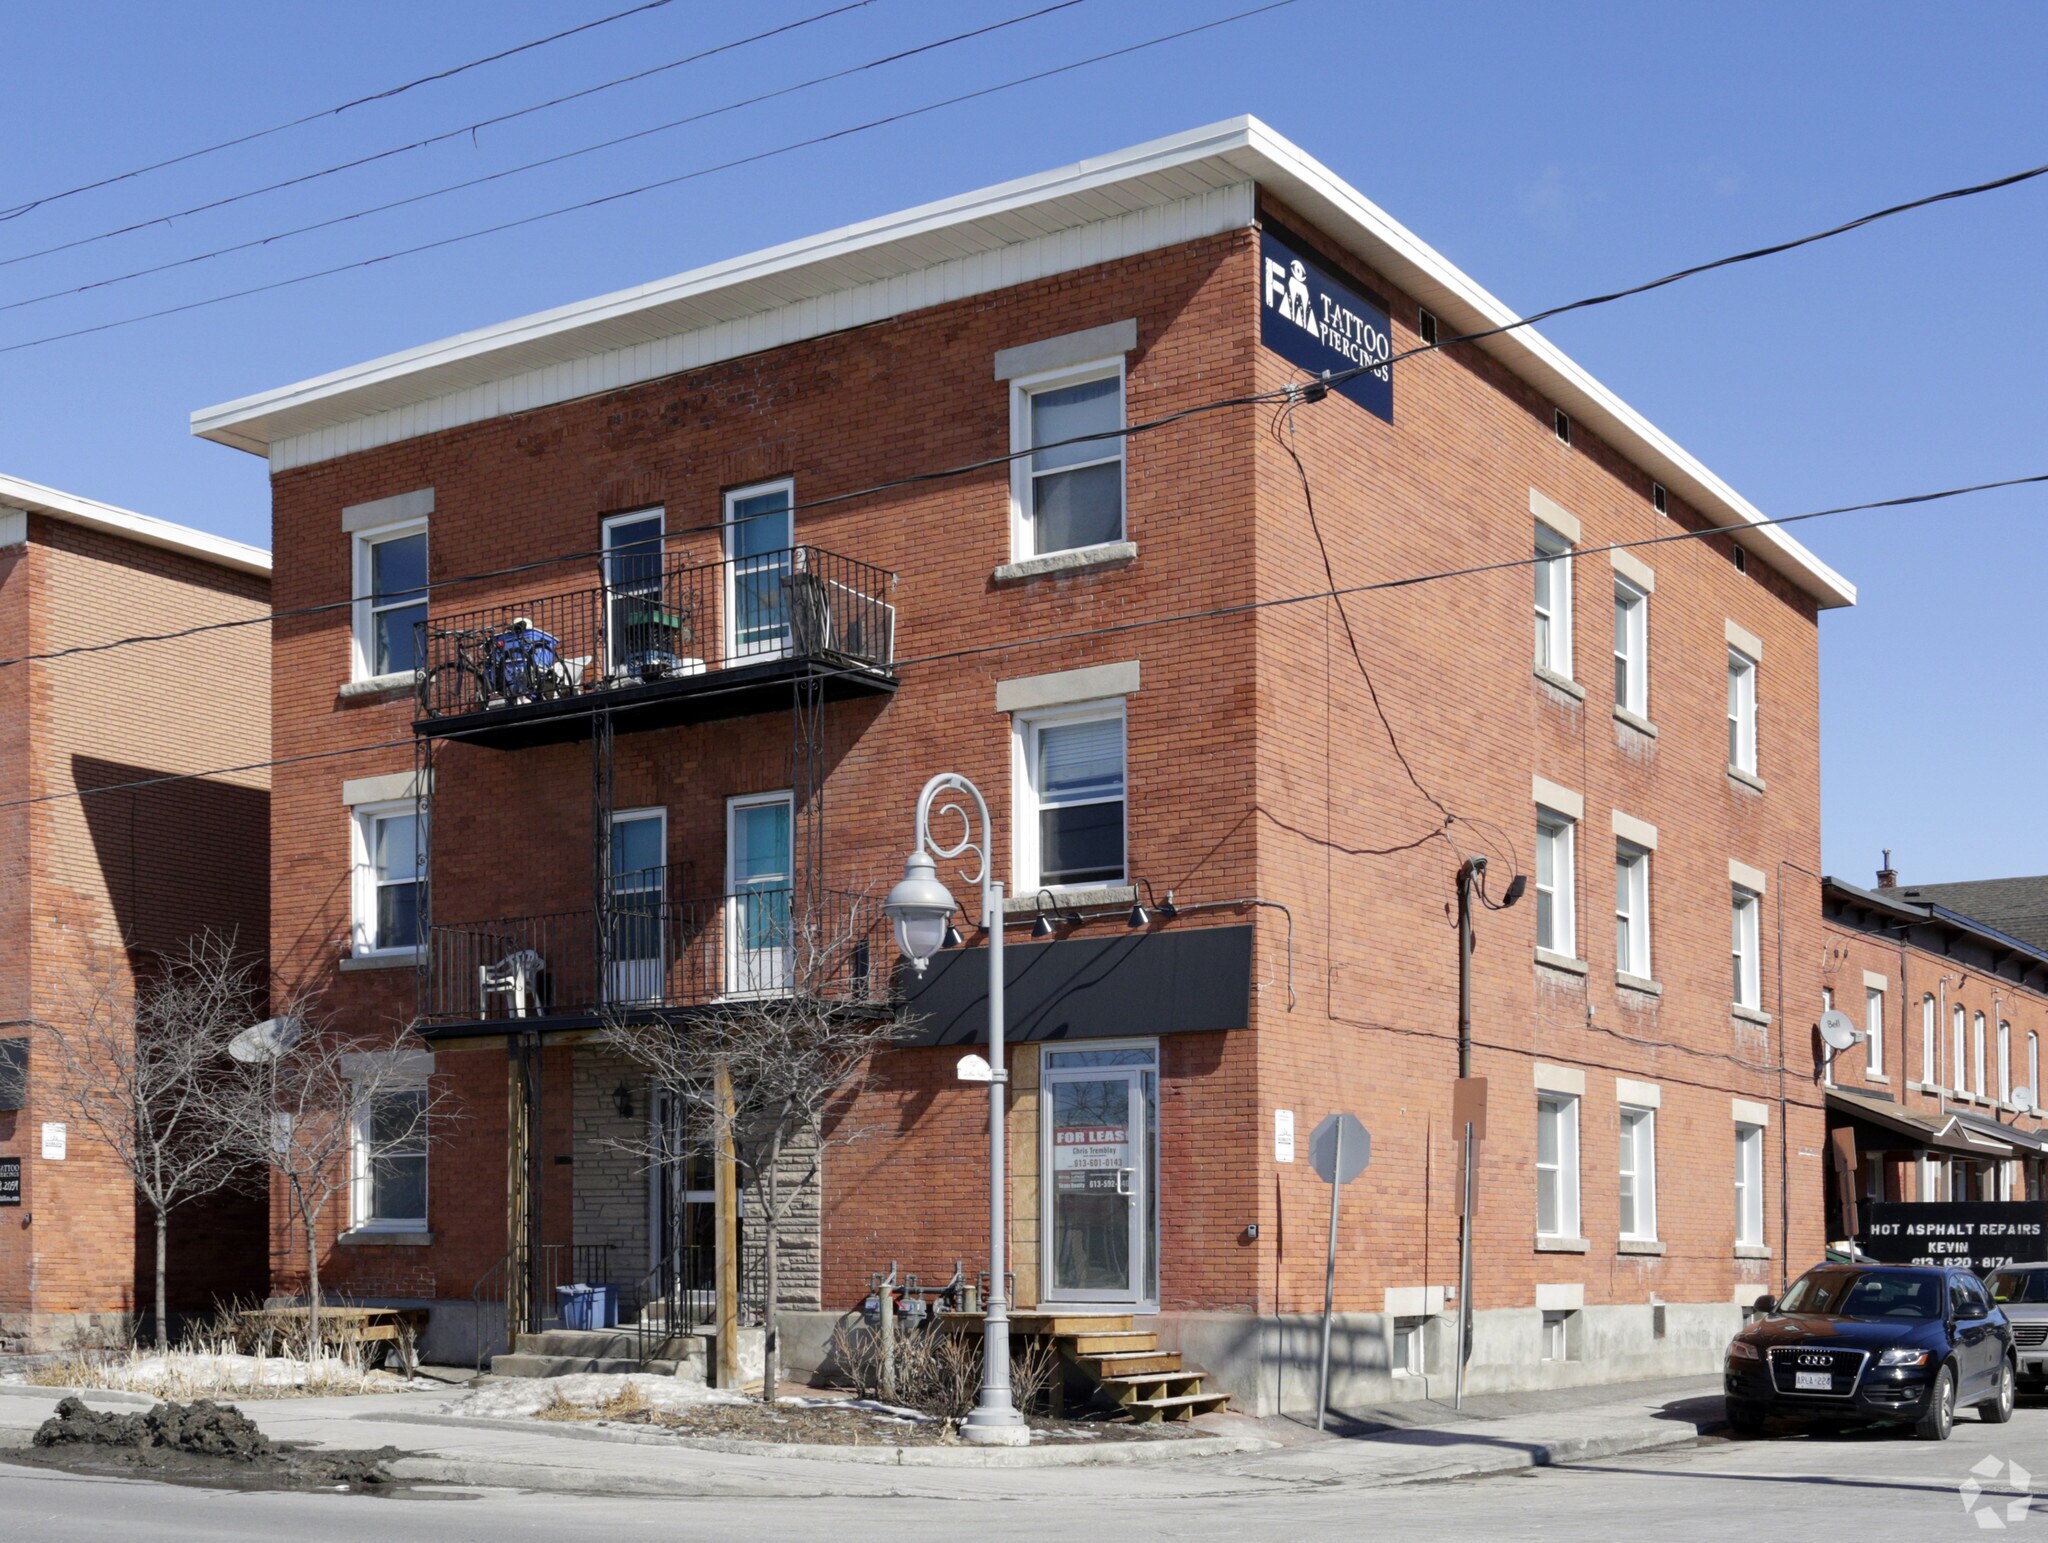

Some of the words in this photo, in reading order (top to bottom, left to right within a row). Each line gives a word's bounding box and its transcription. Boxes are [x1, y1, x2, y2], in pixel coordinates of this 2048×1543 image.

[1320, 293, 1389, 360] TATTOO
[1319, 321, 1389, 382] PIERCINGS
[1056, 1131, 1085, 1143] FOR
[1088, 1130, 1128, 1142] LEAS
[1072, 1147, 1088, 1155] Chris
[1090, 1147, 1116, 1155] Tremblay
[1870, 1224, 1900, 1235] HOT
[1906, 1223, 1975, 1235] ASPHALT
[1979, 1223, 2041, 1235] REPAIRS
[1928, 1241, 1969, 1253] KEVIN
